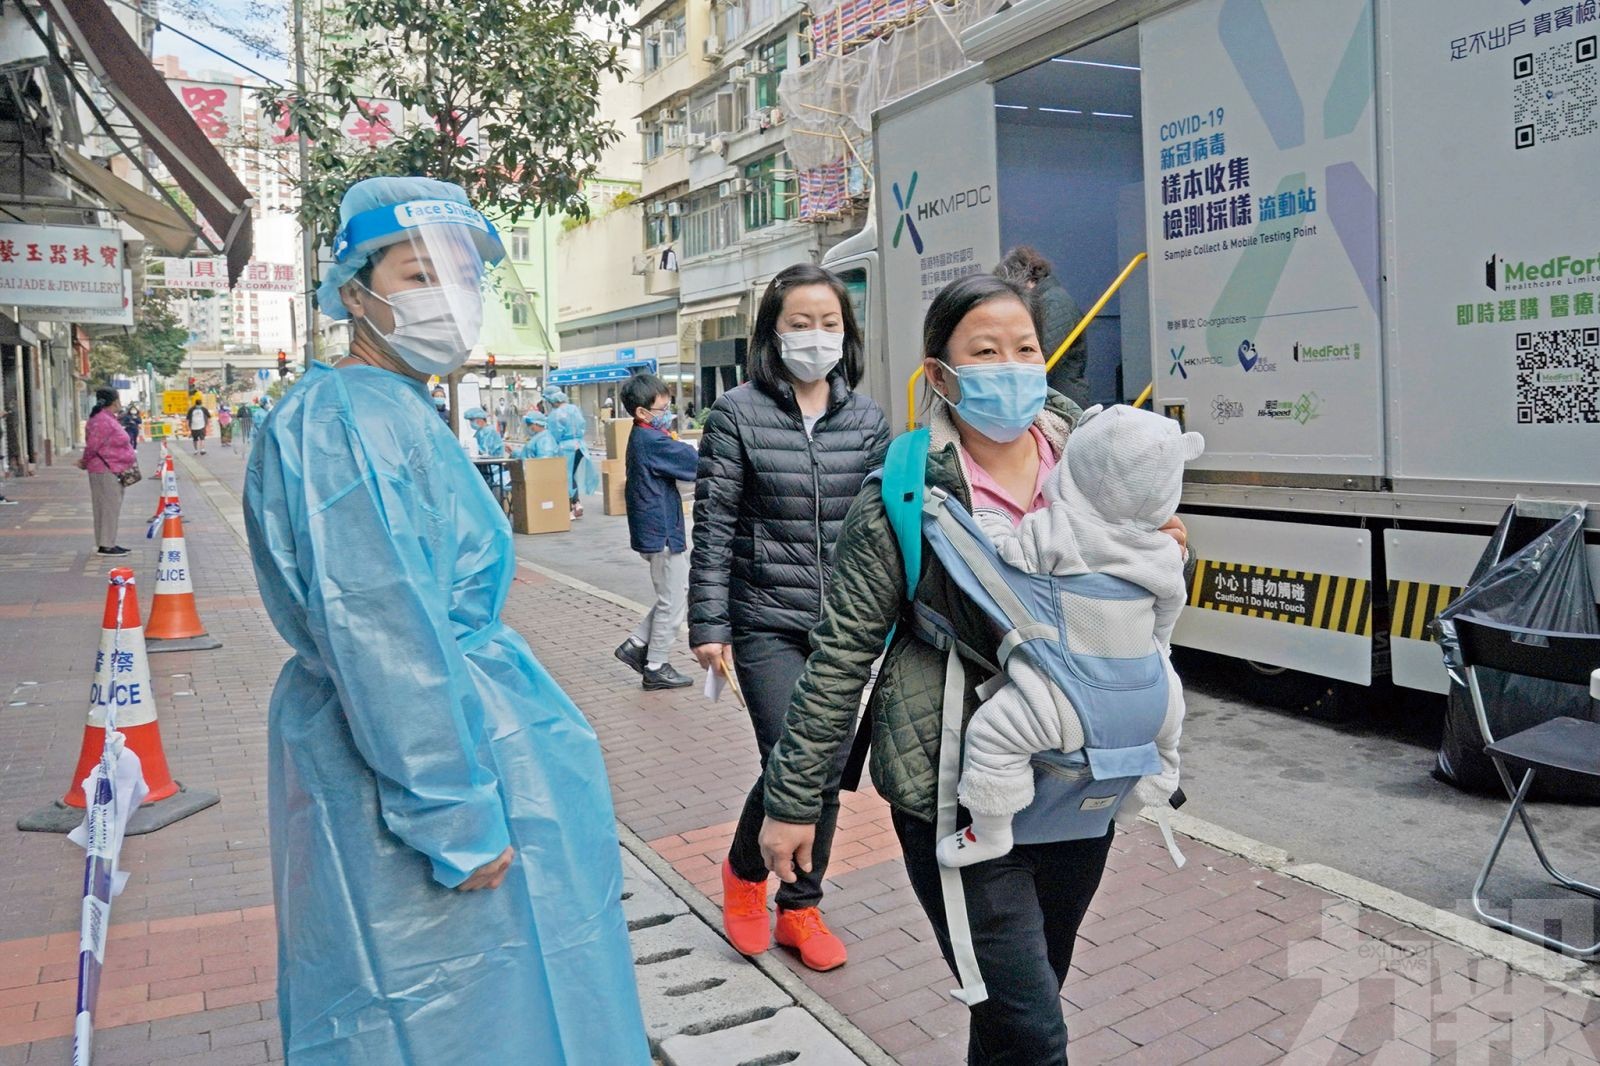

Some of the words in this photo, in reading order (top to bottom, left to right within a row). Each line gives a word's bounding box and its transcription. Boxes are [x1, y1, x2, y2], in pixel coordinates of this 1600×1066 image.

[1450, 19, 1526, 62] 足不出戶
[1533, 0, 1600, 37] 貴賓檢
[1160, 107, 1225, 141] COVID-19
[1160, 132, 1226, 170] 新冠病毒
[1161, 157, 1250, 205] 樣本收集
[404, 204, 441, 217] Face
[917, 184, 992, 221] HKMPDC
[1163, 193, 1252, 240] 檢測採樣
[1259, 186, 1317, 222] 流動站
[1164, 247, 1192, 261] Sample
[1193, 242, 1221, 256] Collect
[1222, 241, 1229, 250] &
[1230, 236, 1258, 249] Mobile
[1260, 230, 1291, 245] Testing
[1293, 225, 1317, 238] Point
[1505, 252, 1600, 283] MedFort
[17, 279, 46, 290] JADE
[48, 280, 55, 291] &
[57, 281, 121, 294] JEWELLERY
[167, 279, 184, 287] FAI
[210, 281, 243, 289] TOOS
[246, 282, 294, 291] COMPANY
[1505, 279, 1562, 291] Healthcare
[1197, 315, 1247, 328] Co-organizers
[1457, 297, 1539, 325] 即時選購
[1550, 291, 1600, 318] 醫療
[1184, 356, 1223, 366] HKMPDC
[1302, 344, 1350, 358] MedFort
[1257, 410, 1292, 418] Hi-Speed
[1215, 591, 1245, 604] Caution
[1250, 597, 1262, 607] Do
[1263, 598, 1278, 609] Not
[1279, 601, 1306, 614] Touch
